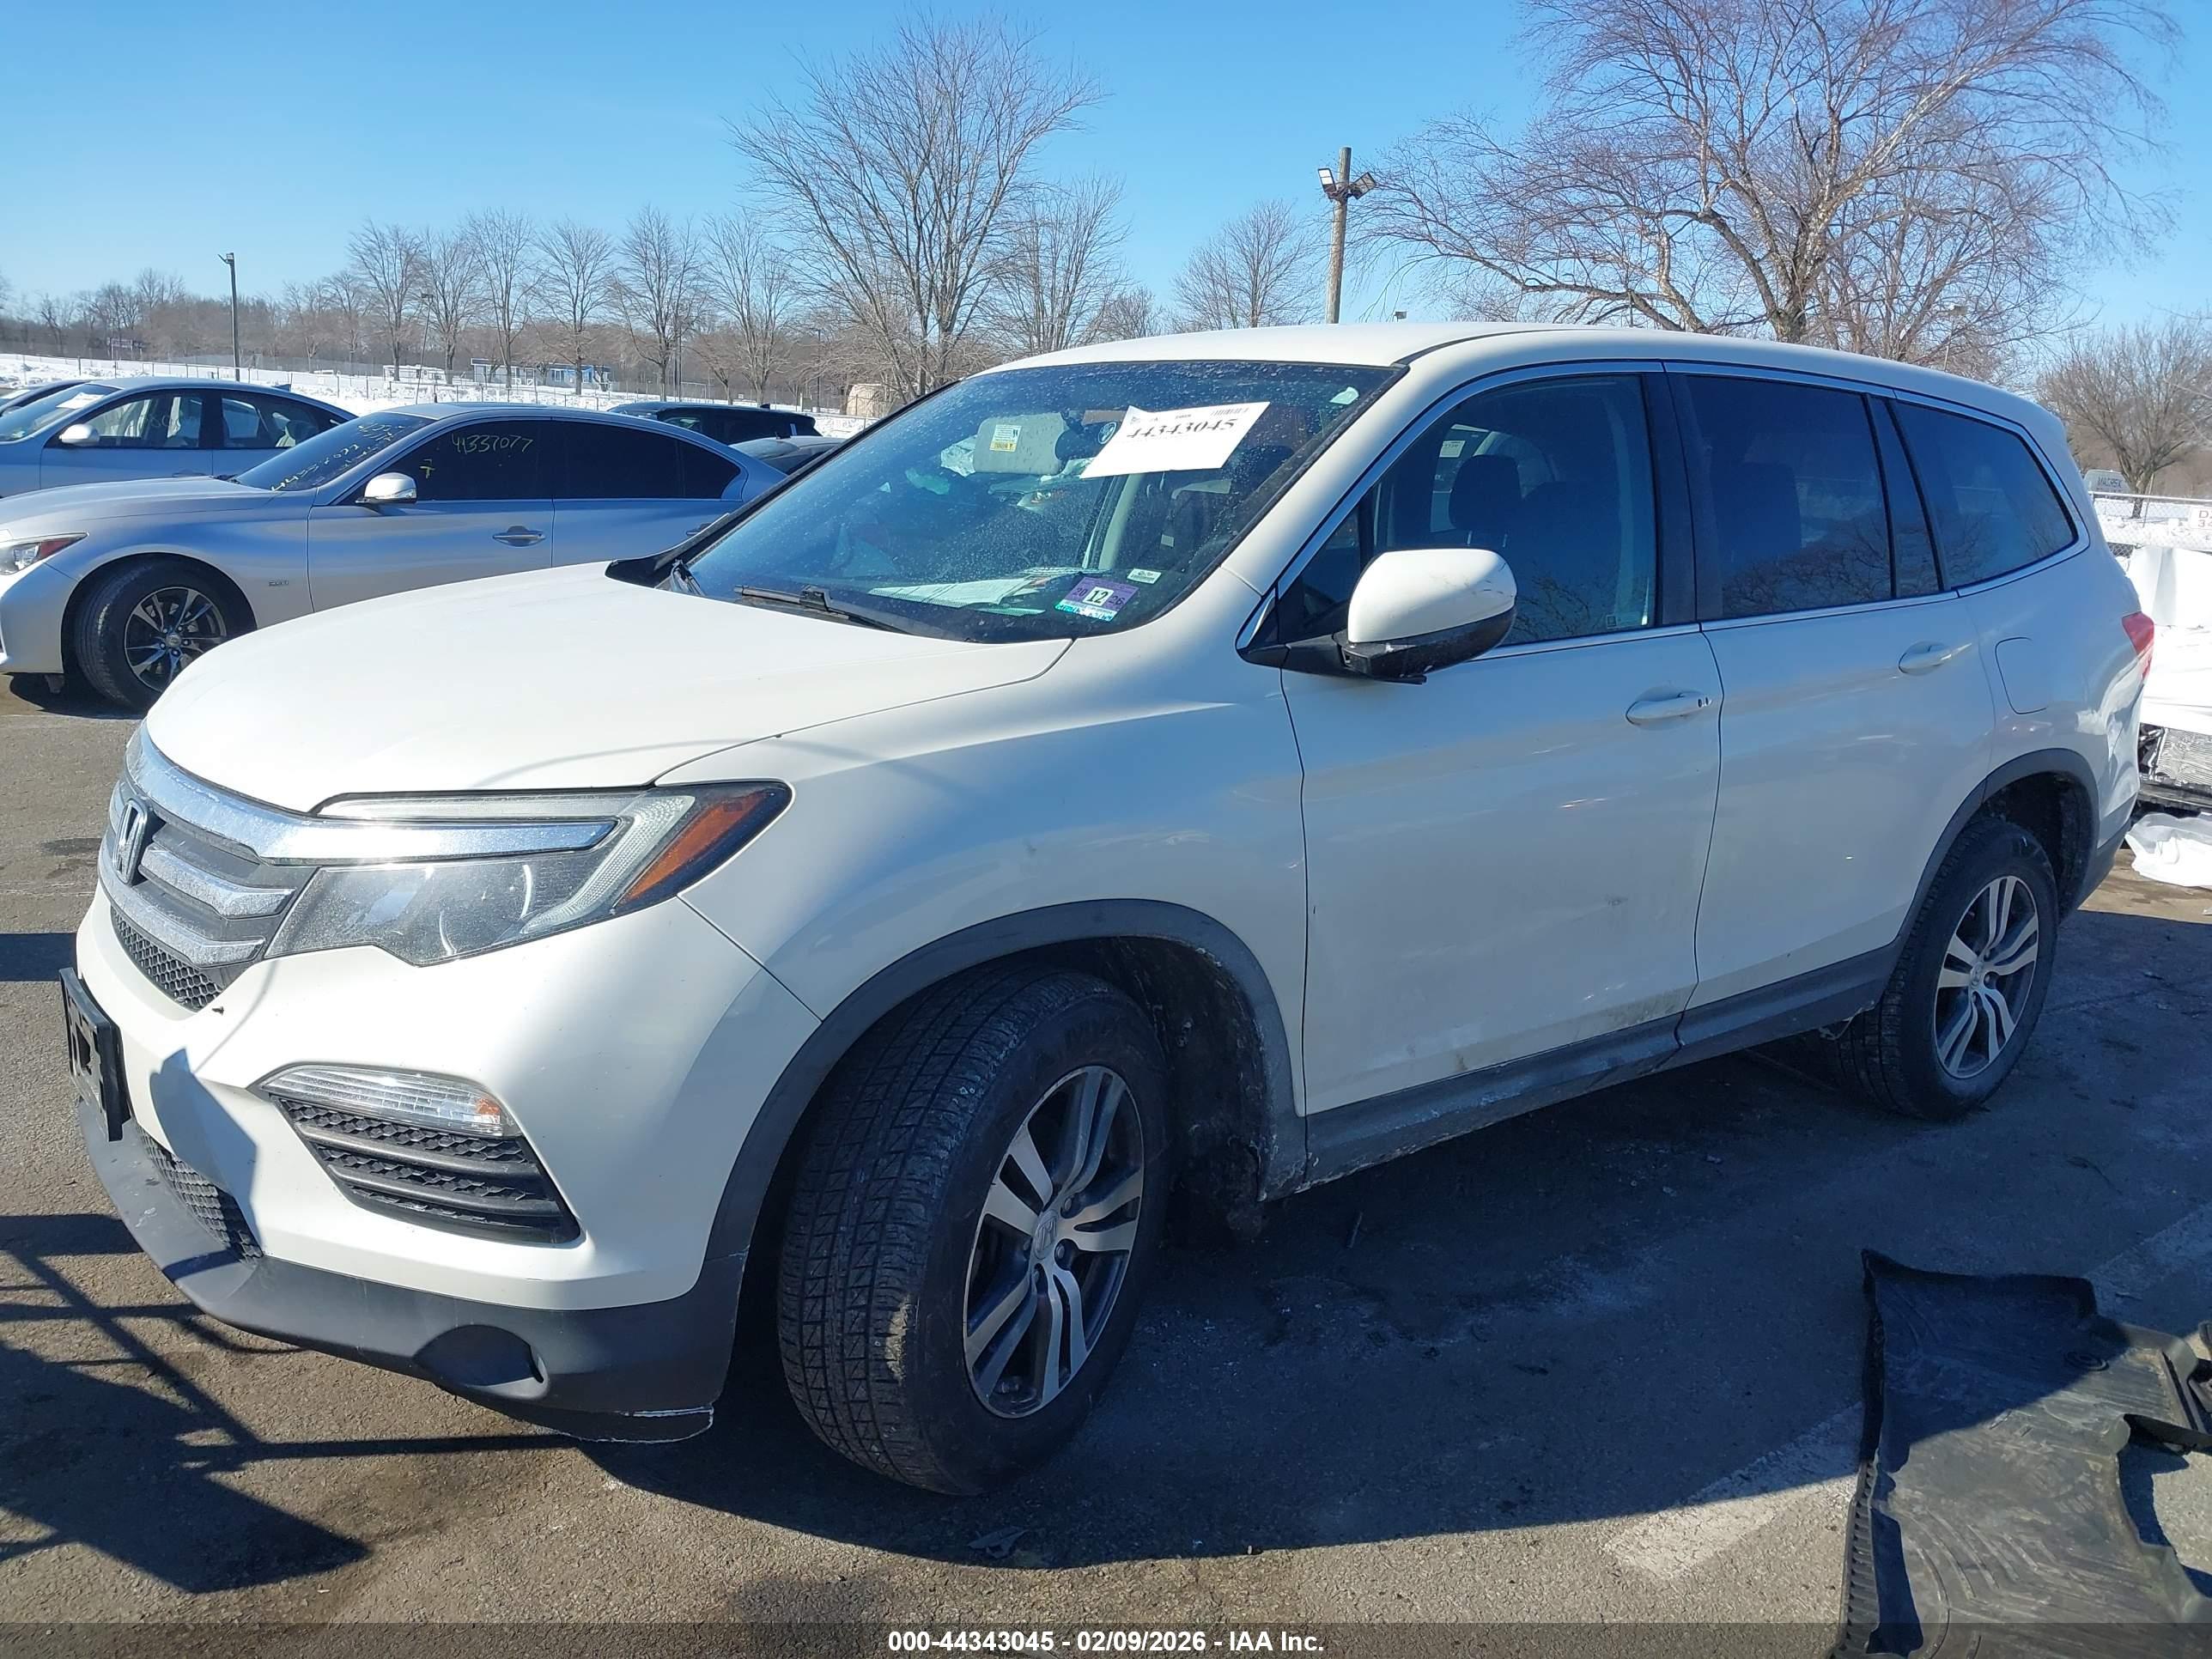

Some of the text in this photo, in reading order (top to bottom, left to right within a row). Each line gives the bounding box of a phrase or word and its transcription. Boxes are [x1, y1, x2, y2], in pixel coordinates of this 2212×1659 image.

[2198, 510, 2212, 519] D
[1073, 586, 1126, 606] 20 12 26
